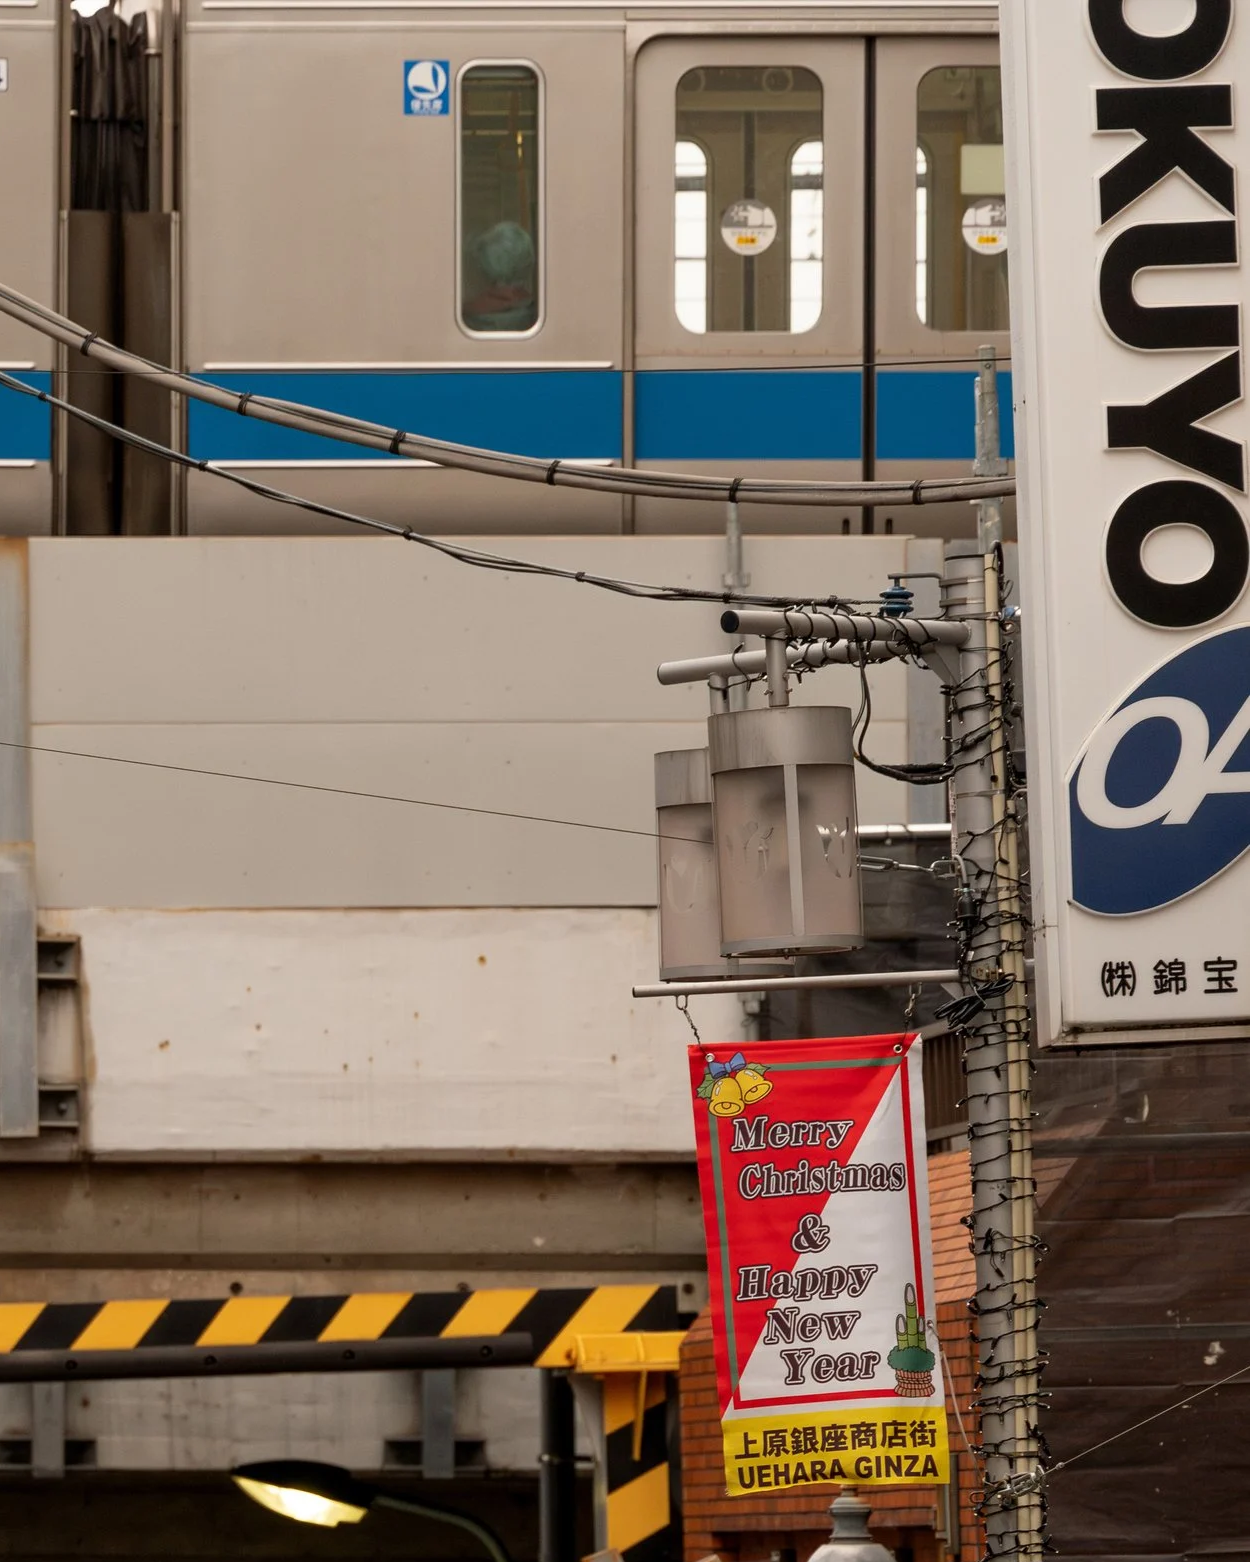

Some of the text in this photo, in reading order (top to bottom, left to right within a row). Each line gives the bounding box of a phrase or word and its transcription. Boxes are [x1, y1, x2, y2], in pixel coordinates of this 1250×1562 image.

[731, 1116, 853, 1151] Merry
[739, 1160, 906, 1199] Christmas
[792, 1213, 830, 1253] &
[737, 1264, 878, 1301] Happy
[763, 1307, 861, 1344] New
[780, 1348, 881, 1386] Year
[734, 1420, 937, 1460] 上原銀座商店街
[738, 1454, 939, 1489] UEHARA GINZA
